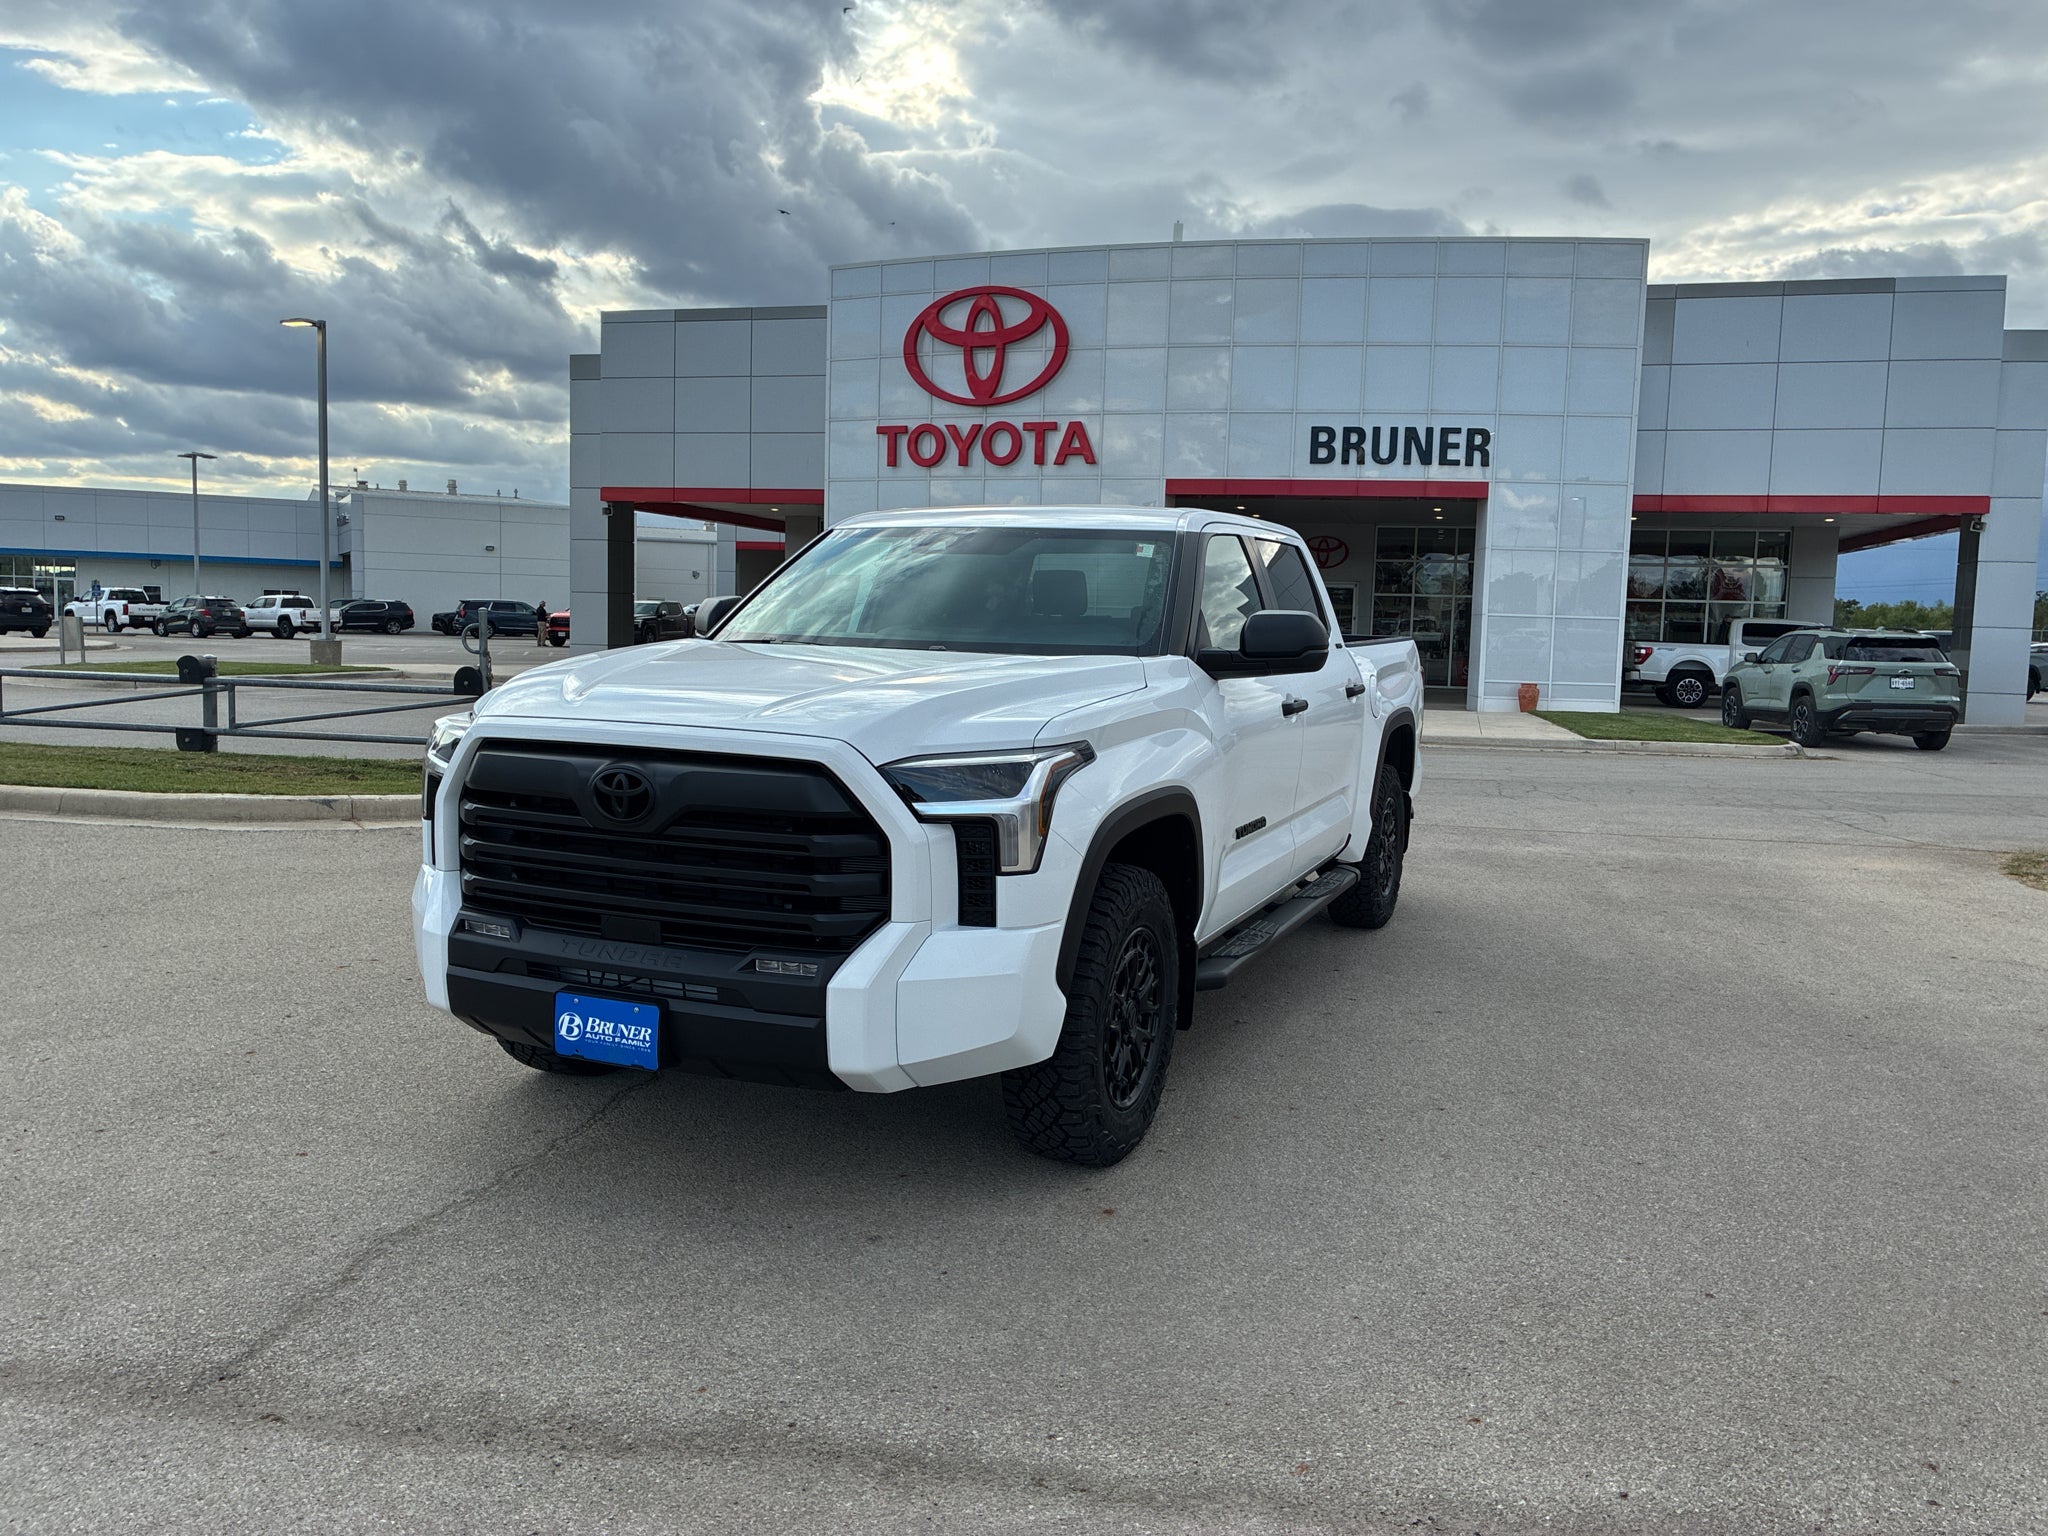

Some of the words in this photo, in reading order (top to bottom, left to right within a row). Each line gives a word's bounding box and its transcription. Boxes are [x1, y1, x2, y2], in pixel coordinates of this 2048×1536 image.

[876, 421, 1097, 467] TOYOTA
[1309, 426, 1491, 467] BRUNER
[584, 1032, 613, 1042] AUTO
[614, 1037, 652, 1048] FAMILY
[585, 1016, 653, 1042] BRUNER
